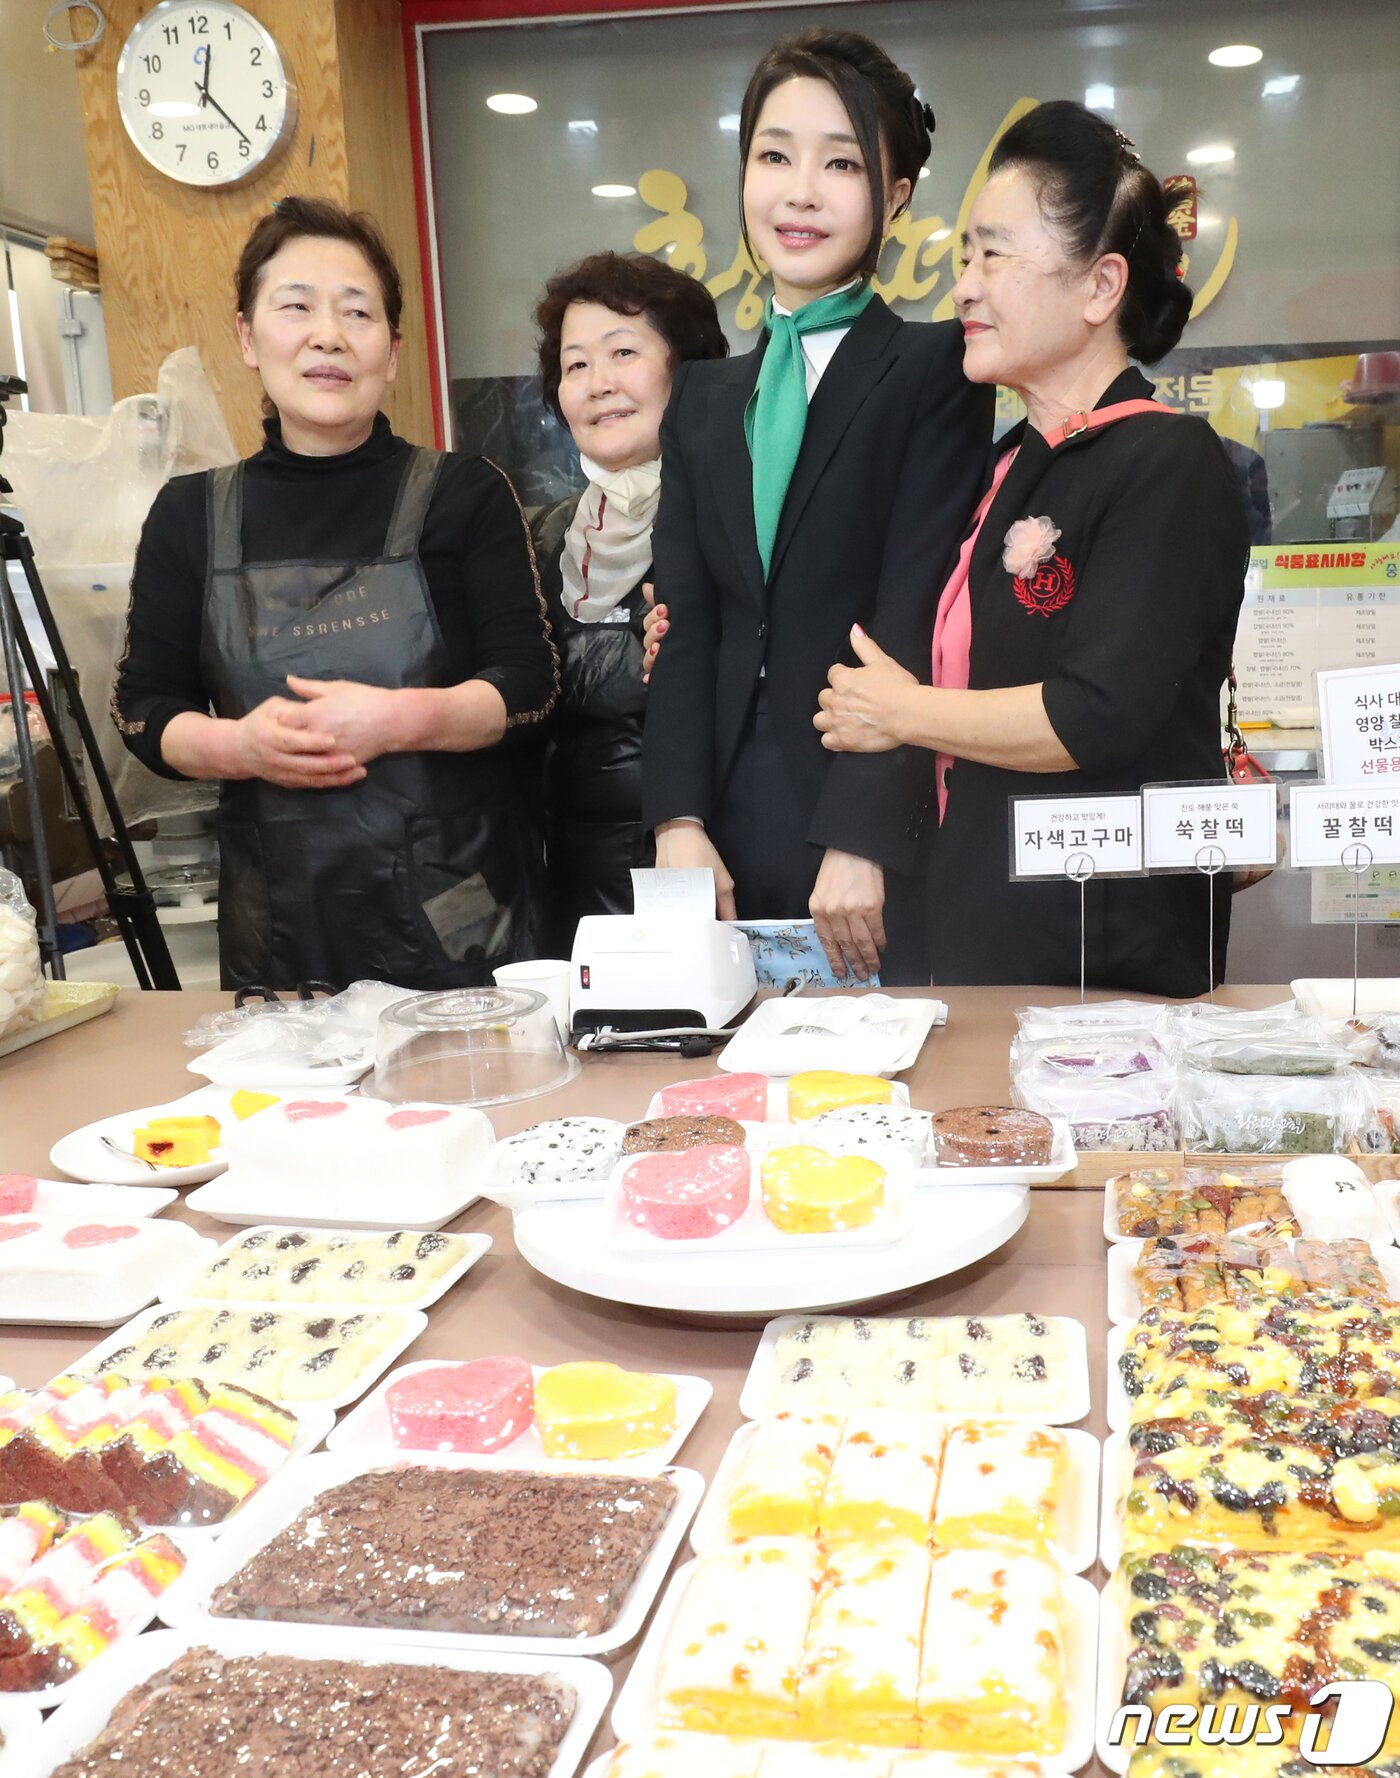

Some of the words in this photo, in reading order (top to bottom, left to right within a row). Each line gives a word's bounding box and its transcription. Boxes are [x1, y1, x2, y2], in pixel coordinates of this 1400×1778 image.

[188, 16, 209, 35] 12
[223, 22, 232, 41] 1
[163, 26, 179, 45] 11
[144, 55, 162, 74] 10
[250, 47, 262, 66] 2
[139, 89, 151, 107] 9
[262, 80, 274, 99] 3
[152, 122, 164, 140] 8
[255, 115, 267, 132] 4
[176, 144, 187, 163] 7
[238, 139, 250, 157] 5
[207, 151, 219, 170] 6
[1354, 693, 1384, 710] 식사
[1356, 715, 1385, 733] 영양
[1369, 737, 1400, 752] 박스
[1317, 801, 1347, 810] 서리태와
[1349, 801, 1364, 810] 꿀로
[1366, 800, 1389, 809] 건강한
[1050, 813, 1079, 822] 건강하고
[1024, 826, 1133, 850] 자색고구마
